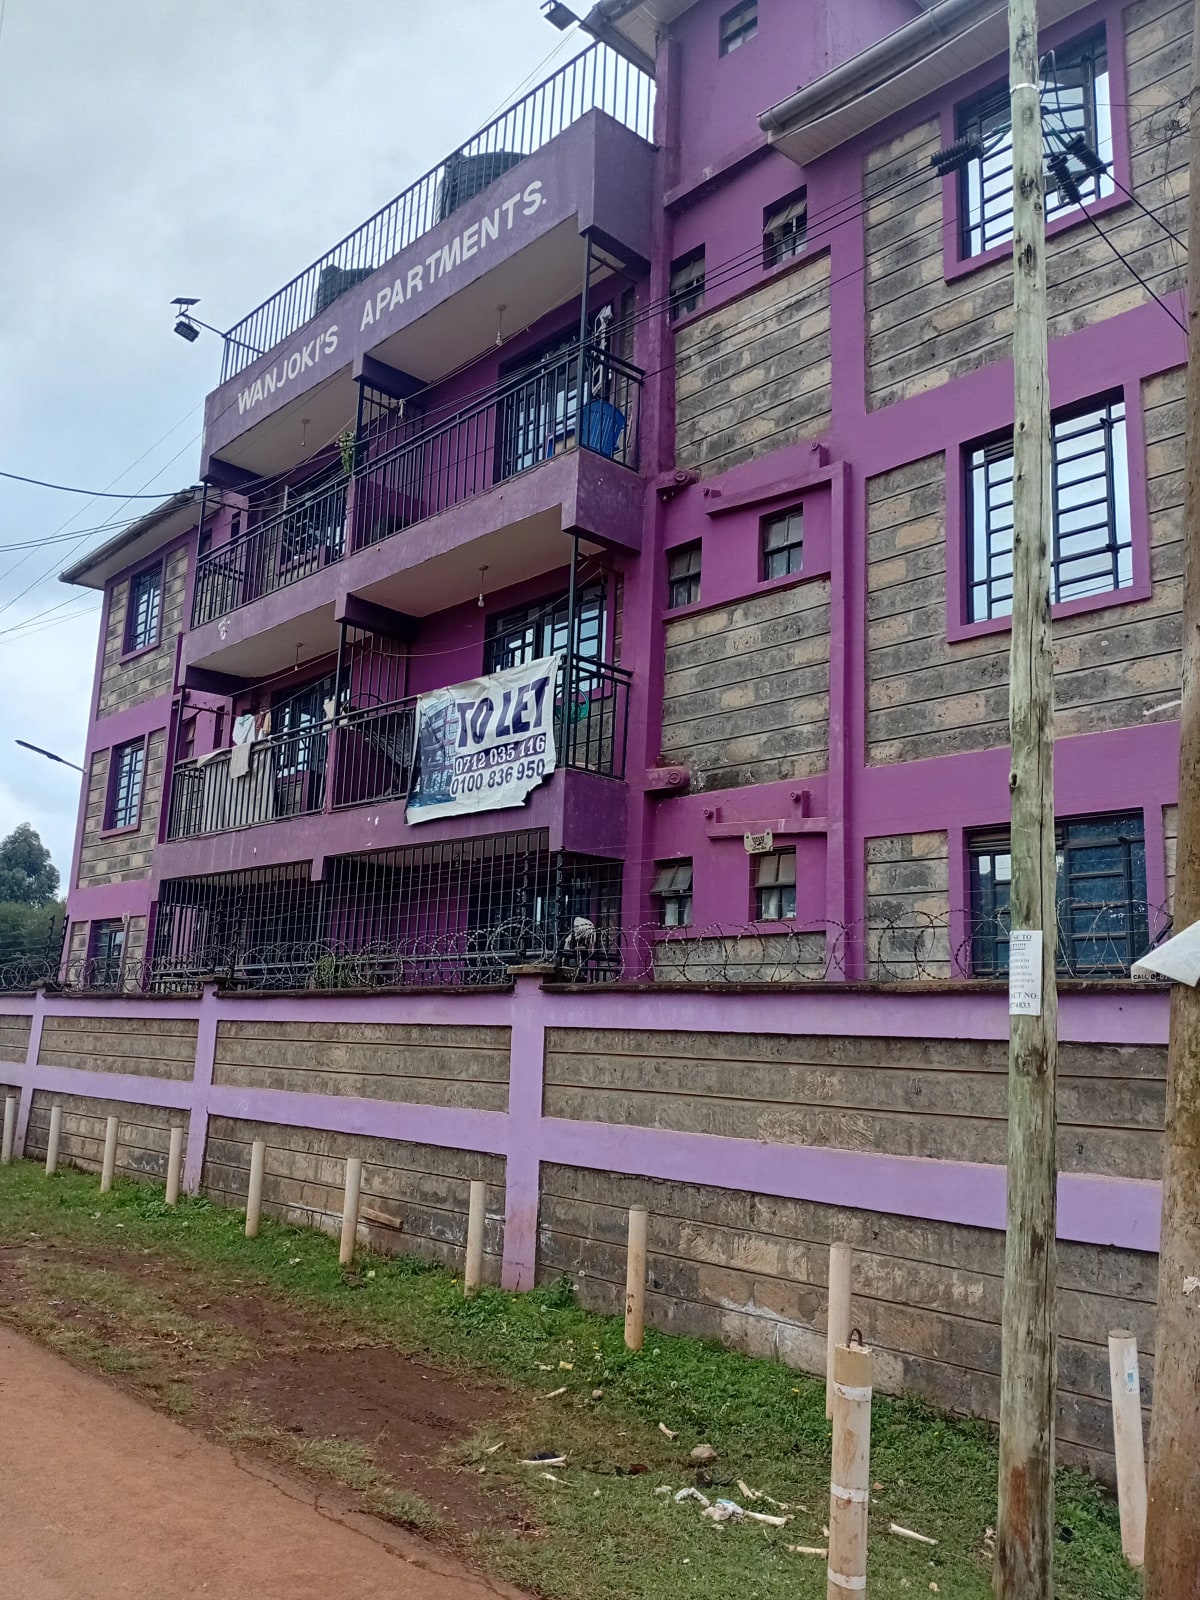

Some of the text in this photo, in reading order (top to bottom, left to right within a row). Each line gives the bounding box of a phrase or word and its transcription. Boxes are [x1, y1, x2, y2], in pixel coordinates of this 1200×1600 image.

[237, 180, 547, 415] WANJOKI'S APARTMENTS.
[456, 676, 550, 748] TO LET
[451, 758, 545, 795] 0100 836 950
[455, 735, 546, 774] 0712 035 116
